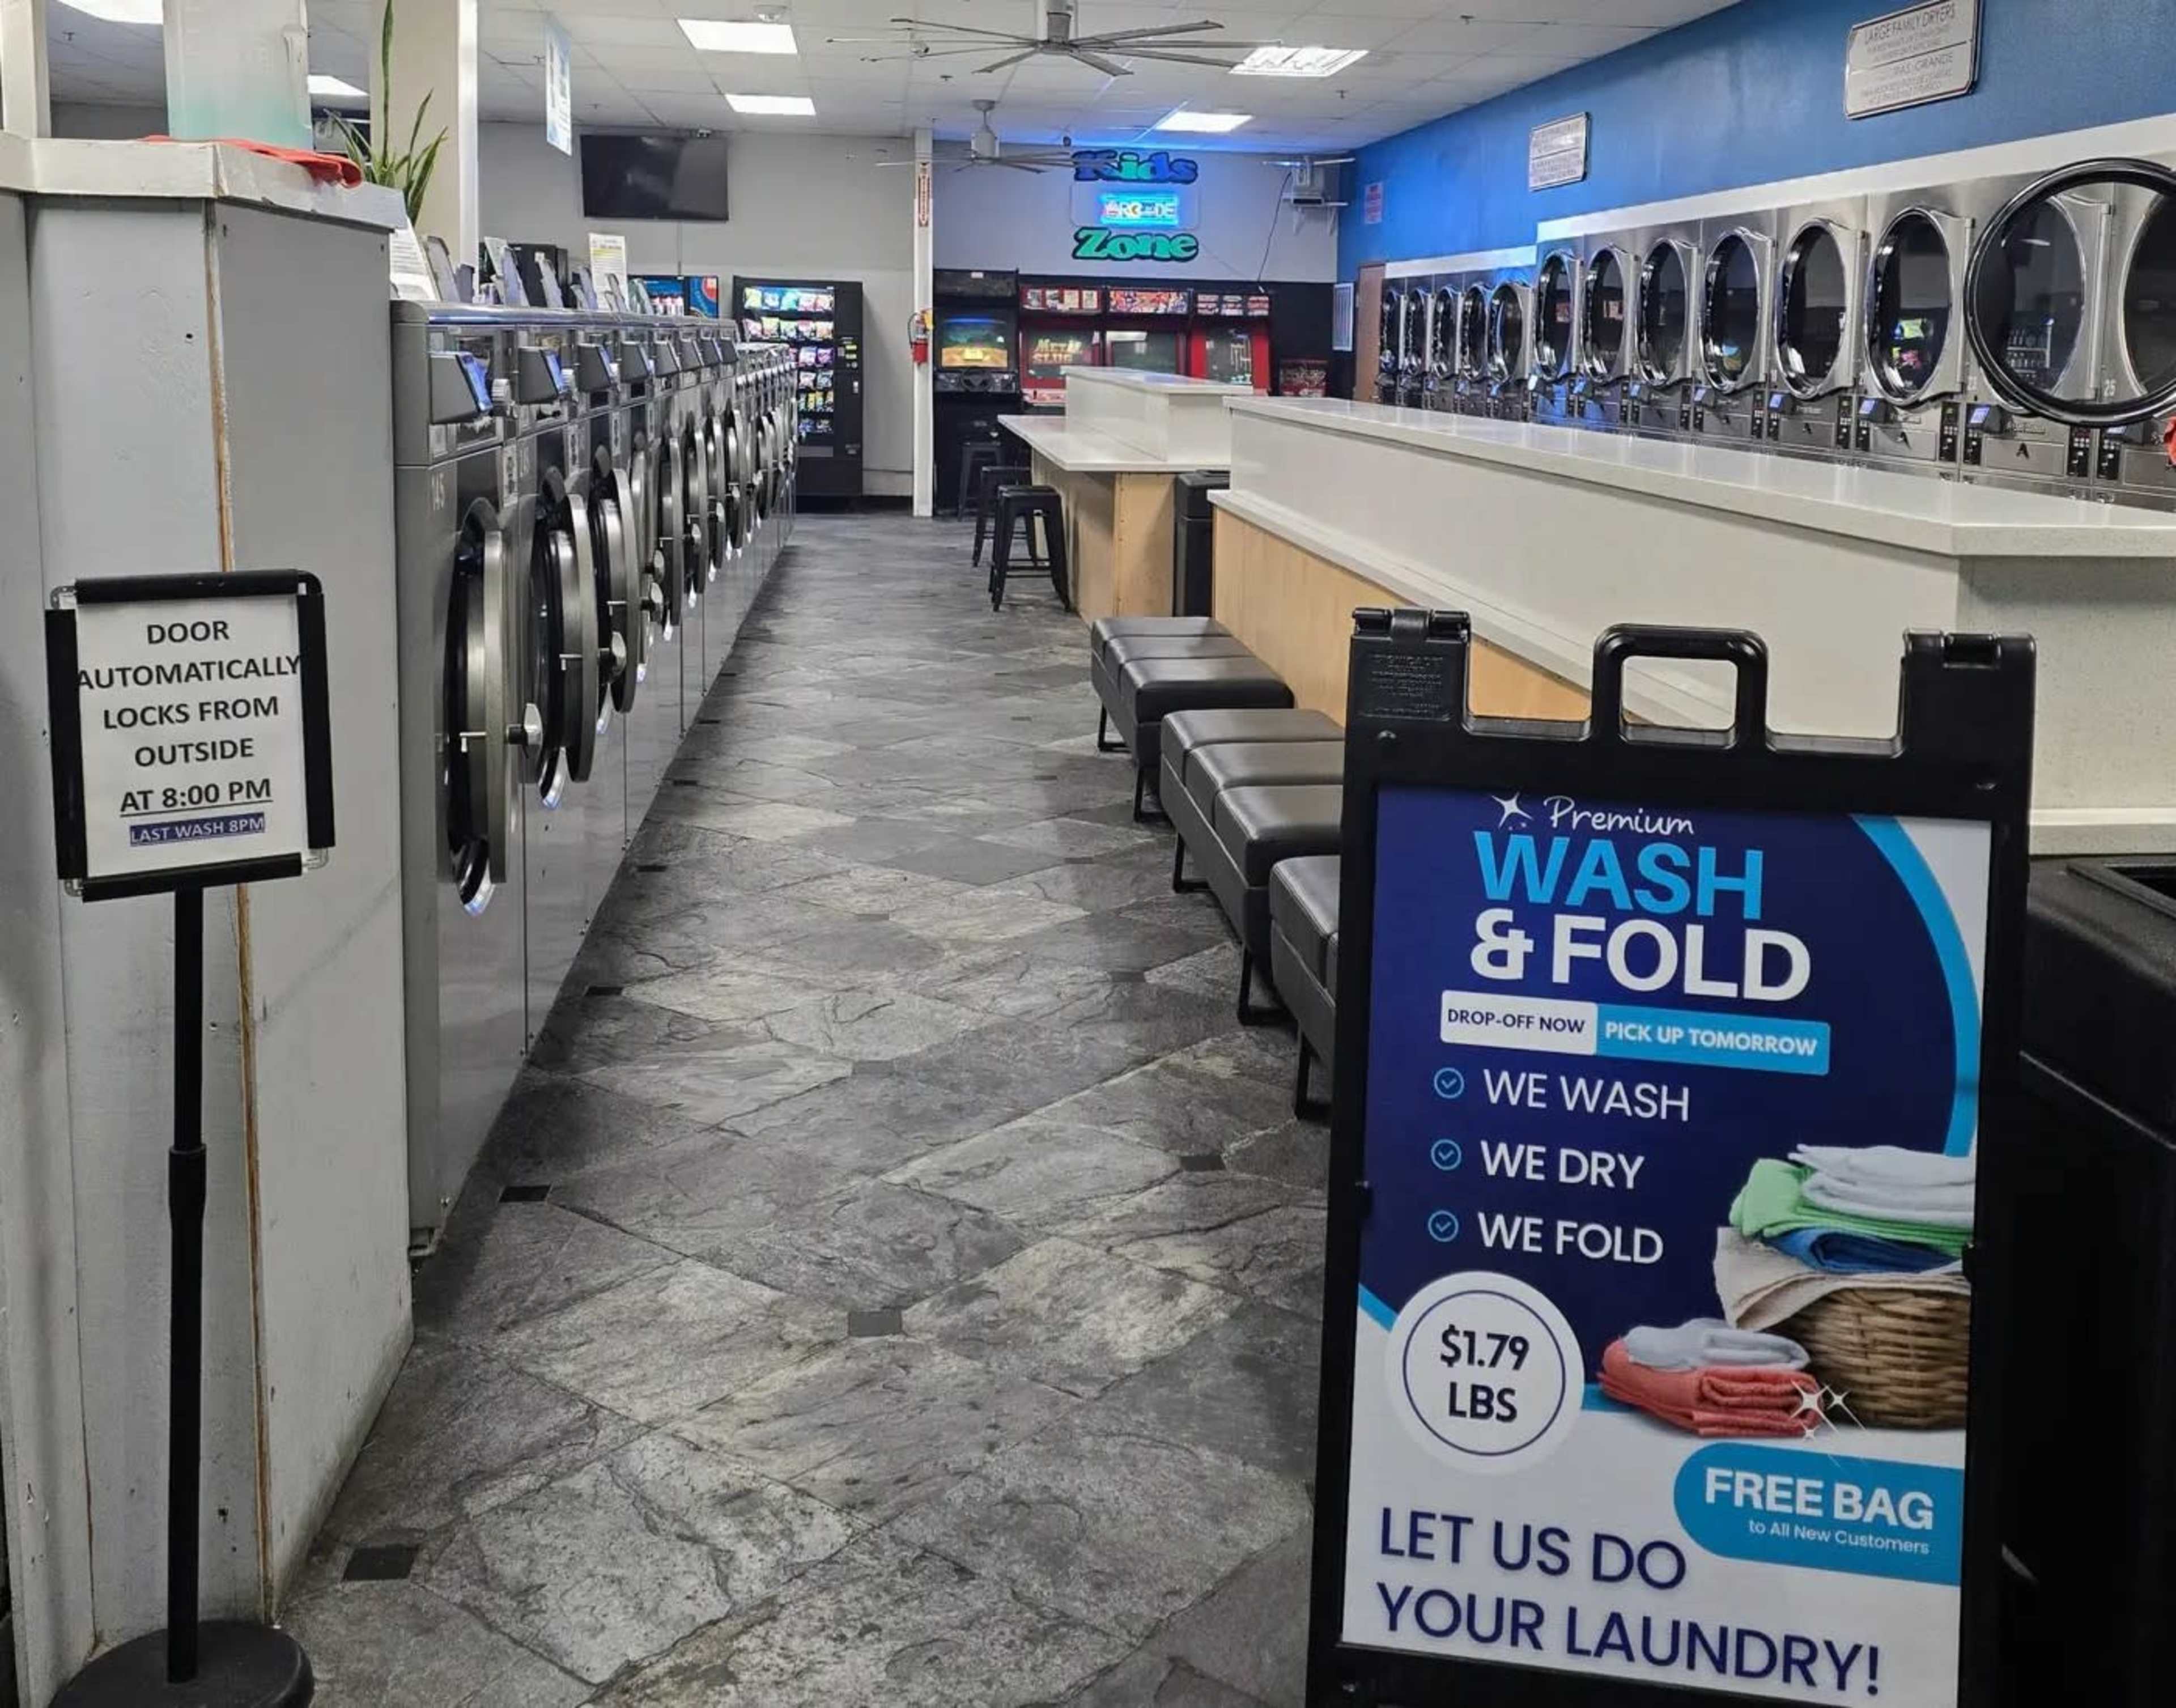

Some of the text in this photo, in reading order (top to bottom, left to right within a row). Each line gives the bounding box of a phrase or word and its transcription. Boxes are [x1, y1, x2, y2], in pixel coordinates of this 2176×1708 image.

[1892, 14, 1920, 35] FAMILY
[1923, 3, 1956, 27] DRYERS
[1072, 150, 1197, 184] Kids
[1073, 227, 1198, 262] Zone
[147, 621, 229, 644] DOOR
[78, 655, 301, 689] AUTOMATICALLY
[104, 696, 278, 729] LOCKS FROM
[135, 738, 254, 767] OUTSIDE
[120, 778, 271, 812] AT 8:00 PM
[131, 816, 264, 843] LAST WASH 8PM
[1544, 795, 1694, 835] Premium
[1473, 830, 1763, 920] WASH
[1470, 908, 1810, 1002] & FOLD
[1447, 1009, 1585, 1034] DROP-OFF NOW
[1605, 1021, 1817, 1056] PICK UP TOMORROW
[1484, 1069, 1688, 1121] WE WASH
[1481, 1140, 1644, 1189] WE DRY
[1478, 1212, 1663, 1264] WE FOLD
[1440, 1324, 1529, 1371] $1.79
[1448, 1382, 1518, 1423] LBS
[1706, 1468, 1933, 1529] FREE BAG
[1380, 1507, 1686, 1590] LET US DO
[1749, 1520, 1930, 1554] to All New Customers
[1376, 1582, 1878, 1697] YOUR LAUNDRY!
